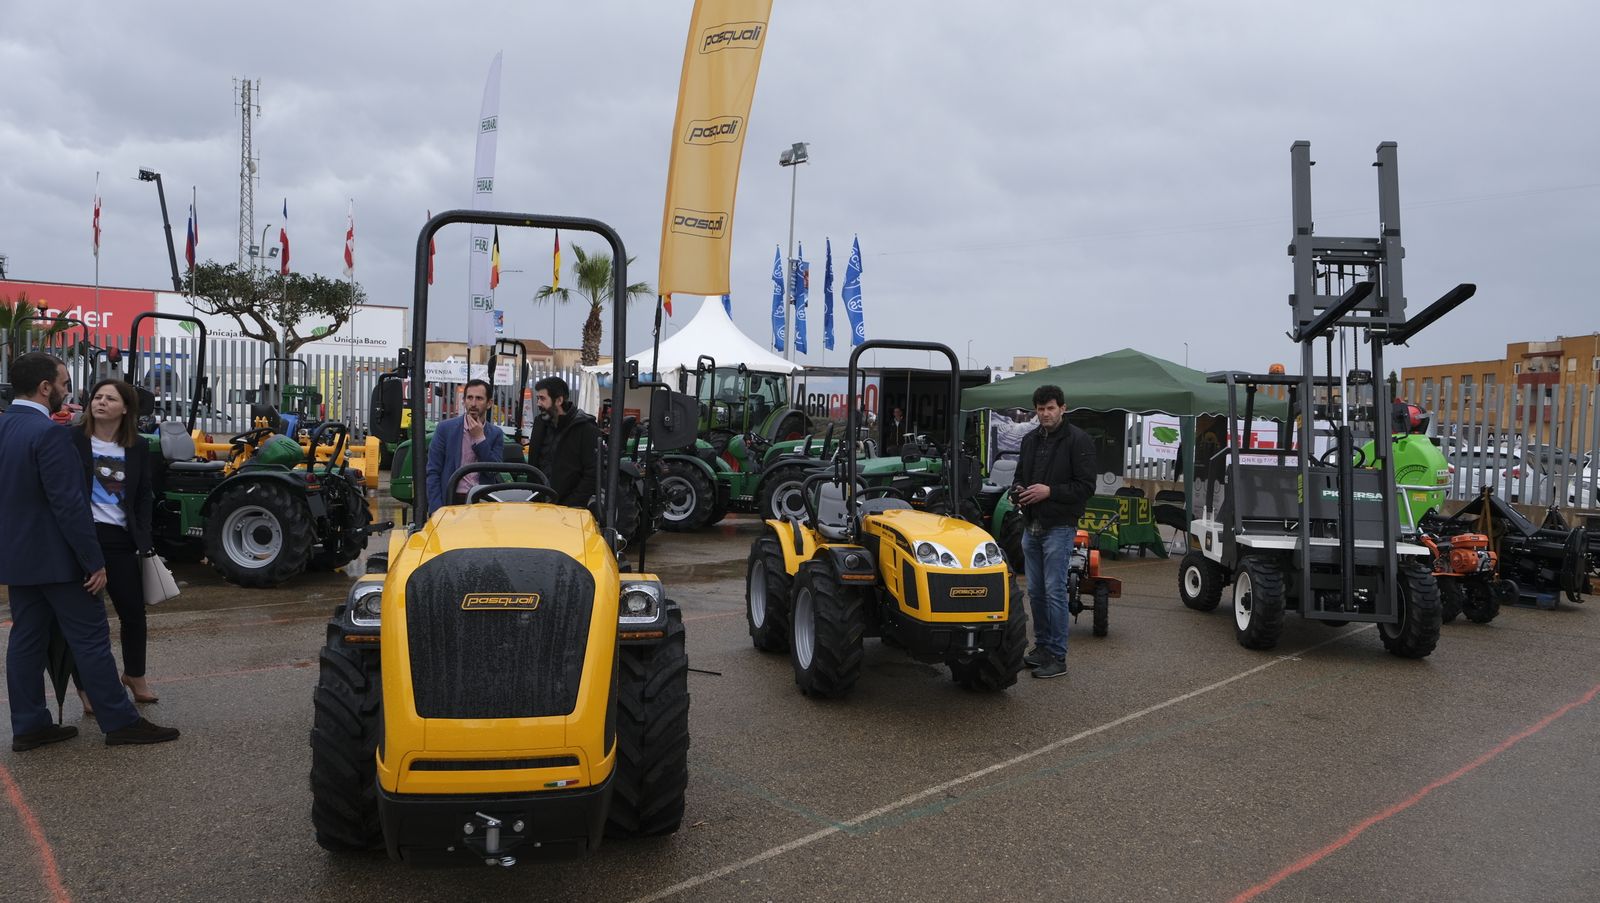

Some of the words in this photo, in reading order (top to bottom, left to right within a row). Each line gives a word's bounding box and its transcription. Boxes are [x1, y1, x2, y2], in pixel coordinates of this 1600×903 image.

[703, 25, 762, 51] pasquali
[206, 329, 238, 338] Unicaja
[334, 336, 364, 345] Unicaja
[467, 596, 534, 607] pasquali
